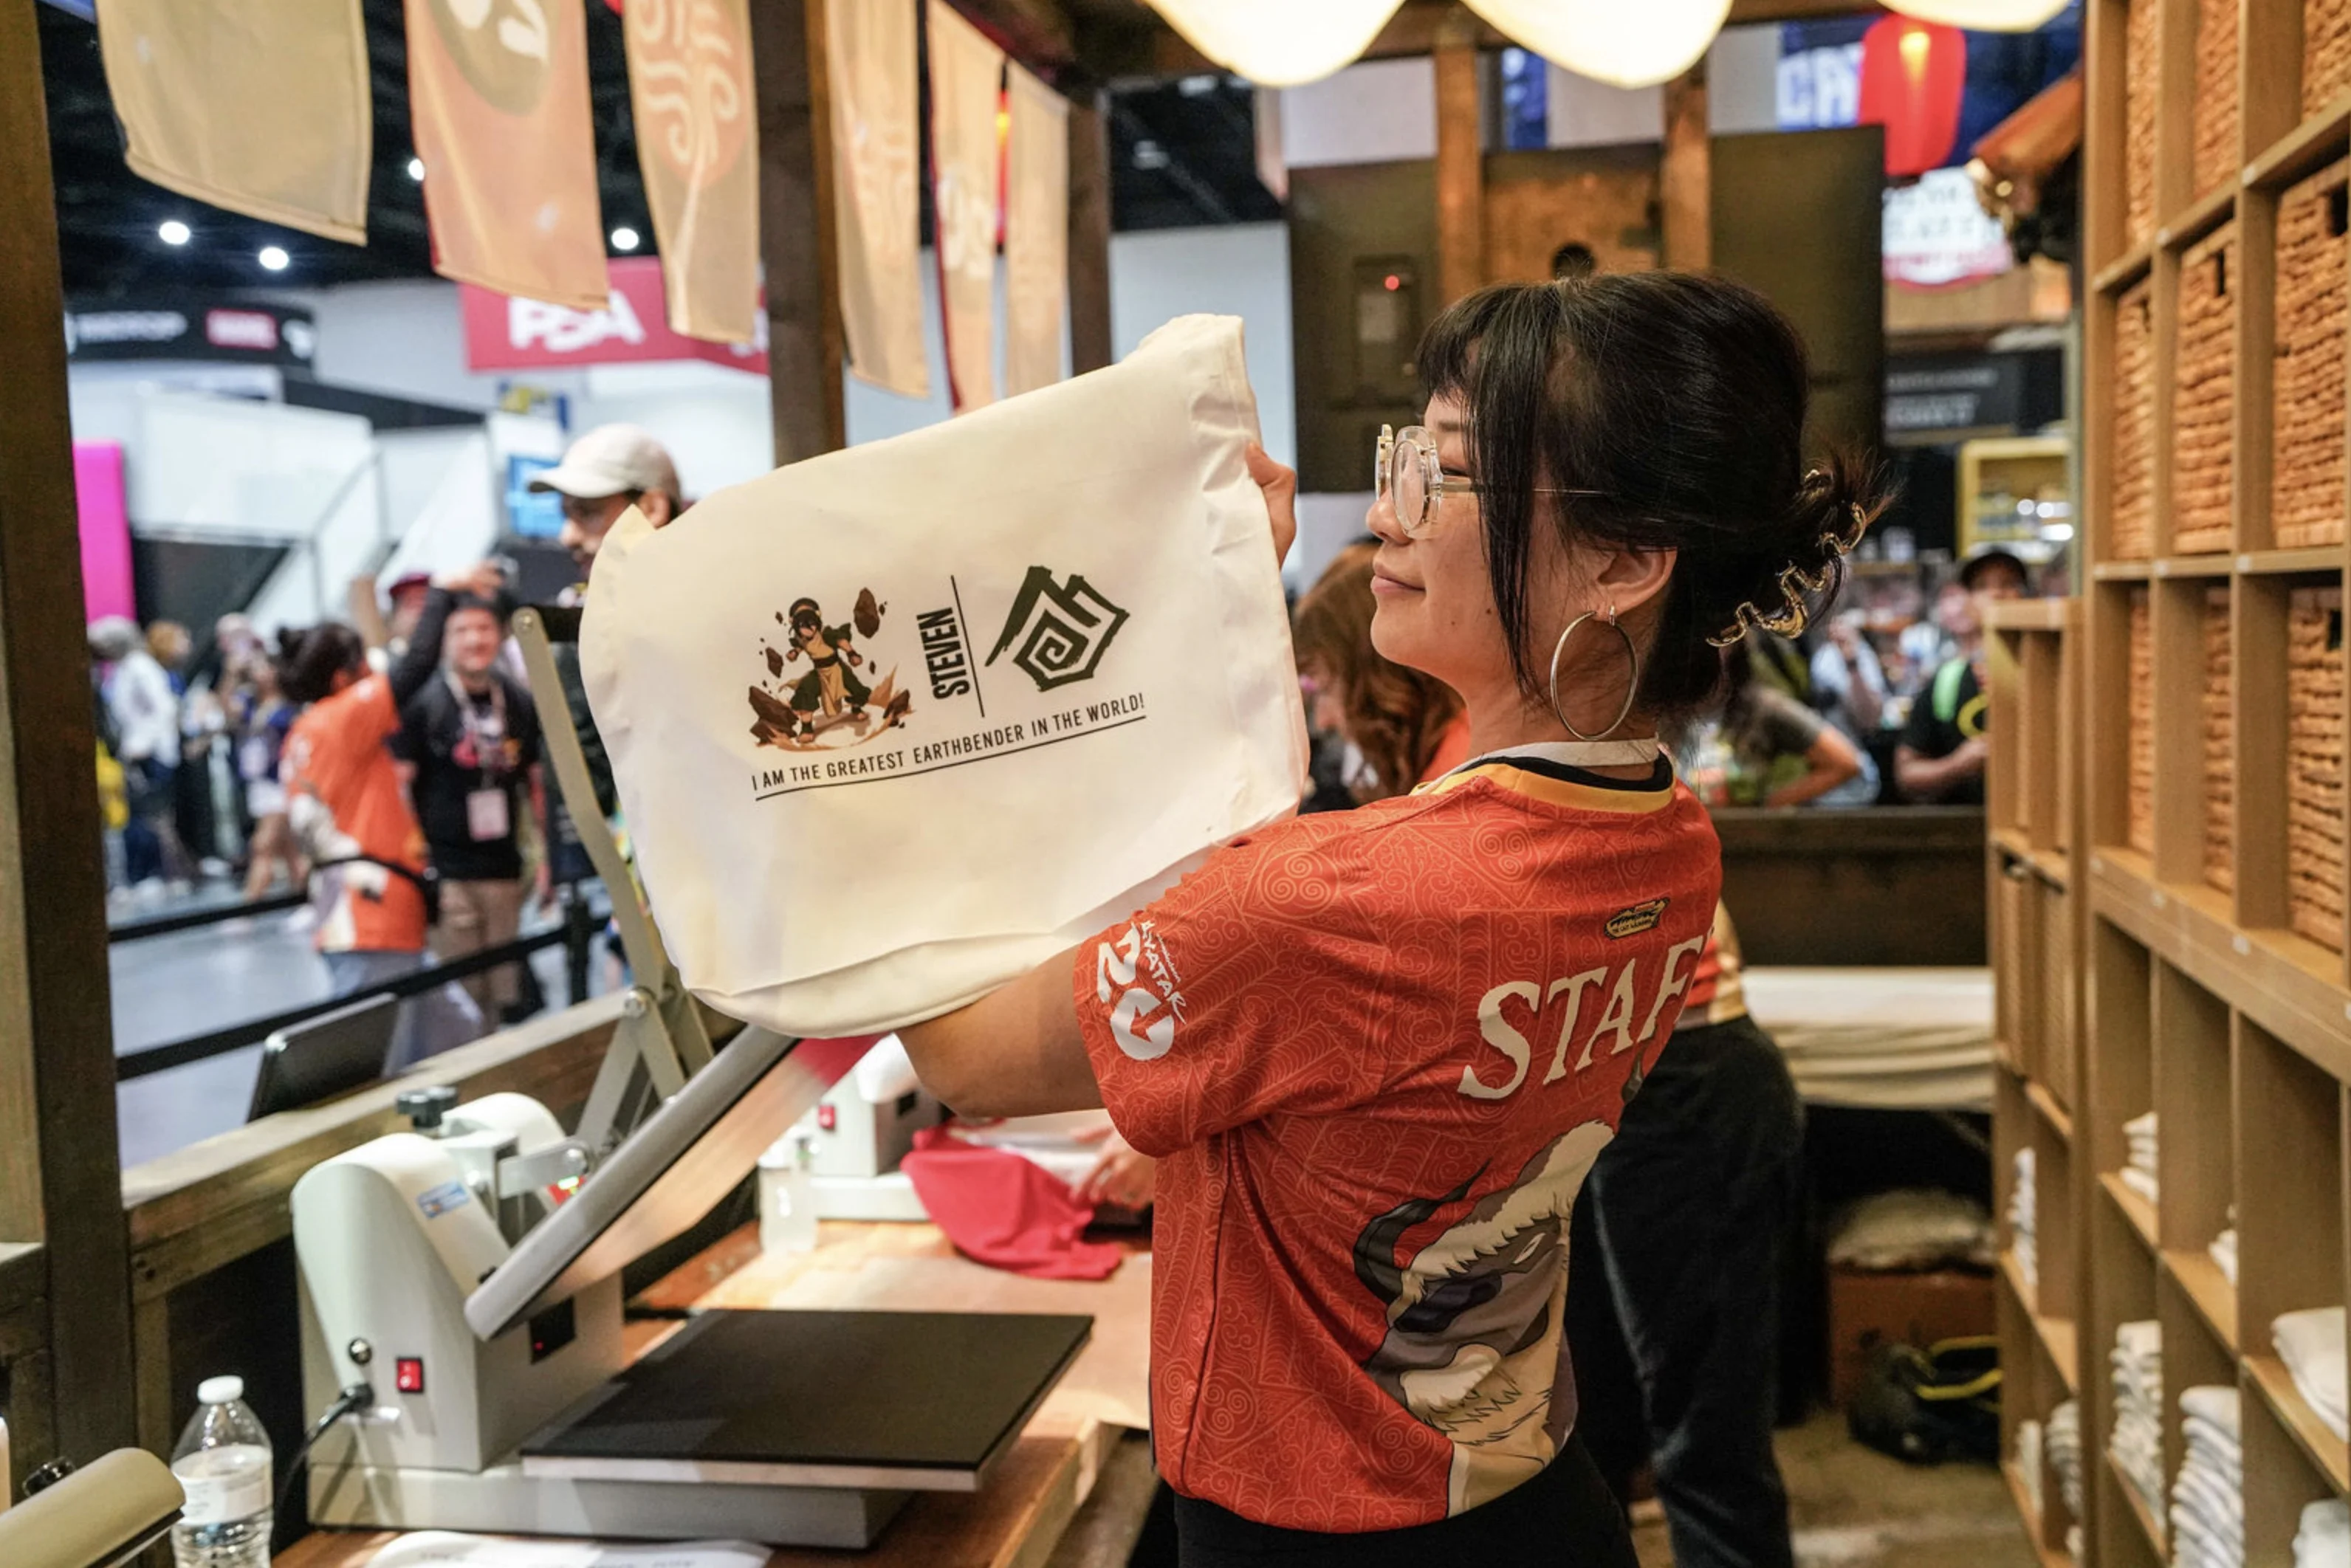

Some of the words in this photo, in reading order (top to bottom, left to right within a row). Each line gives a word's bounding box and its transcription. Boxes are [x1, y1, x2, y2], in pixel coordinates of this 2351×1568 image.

[1776, 42, 1864, 127] CA
[916, 607, 970, 699] STEVEN
[752, 775, 758, 791] I
[763, 769, 785, 789] AM
[790, 763, 821, 782] THE
[826, 751, 904, 777] GREATEST
[913, 724, 1024, 764] EARTHBENDER
[1032, 720, 1048, 737] IN
[1052, 709, 1083, 731] THE
[1086, 692, 1145, 722] WORLD!
[1141, 920, 1187, 1025] AVATAR
[1458, 928, 1713, 1100] STAF
